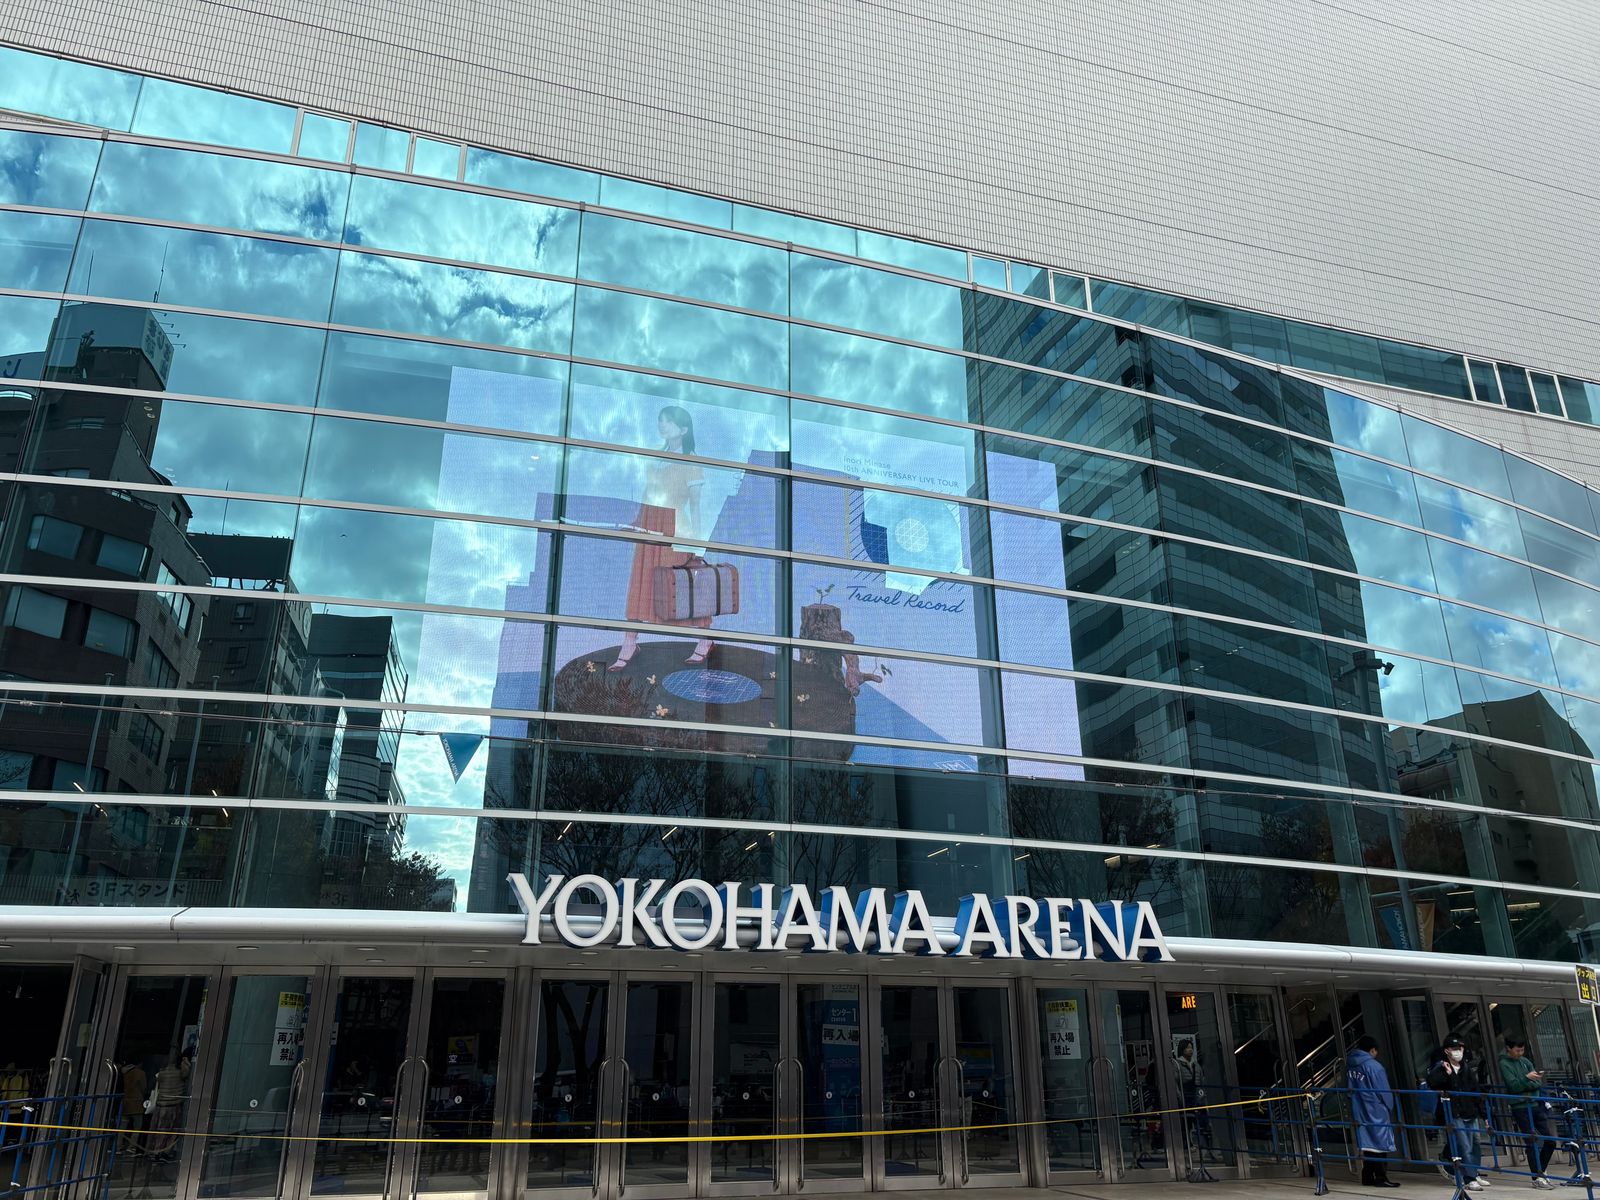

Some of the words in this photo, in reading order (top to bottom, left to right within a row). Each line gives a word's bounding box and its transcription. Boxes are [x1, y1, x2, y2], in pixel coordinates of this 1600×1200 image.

[843, 465, 859, 473] 10th
[861, 468, 917, 481] ANNIVERSARY
[919, 477, 935, 486] LIVE
[937, 479, 960, 489] TOUR
[846, 585, 901, 606] Travel
[903, 593, 966, 614] Record
[505, 872, 945, 956] YOKOHAMA
[950, 891, 1177, 963] ARENA
[1580, 982, 1598, 1001] 出口
[1181, 995, 1197, 1009] ARE
[1049, 1032, 1075, 1043] 再入場
[1054, 1044, 1072, 1057] 禁止
